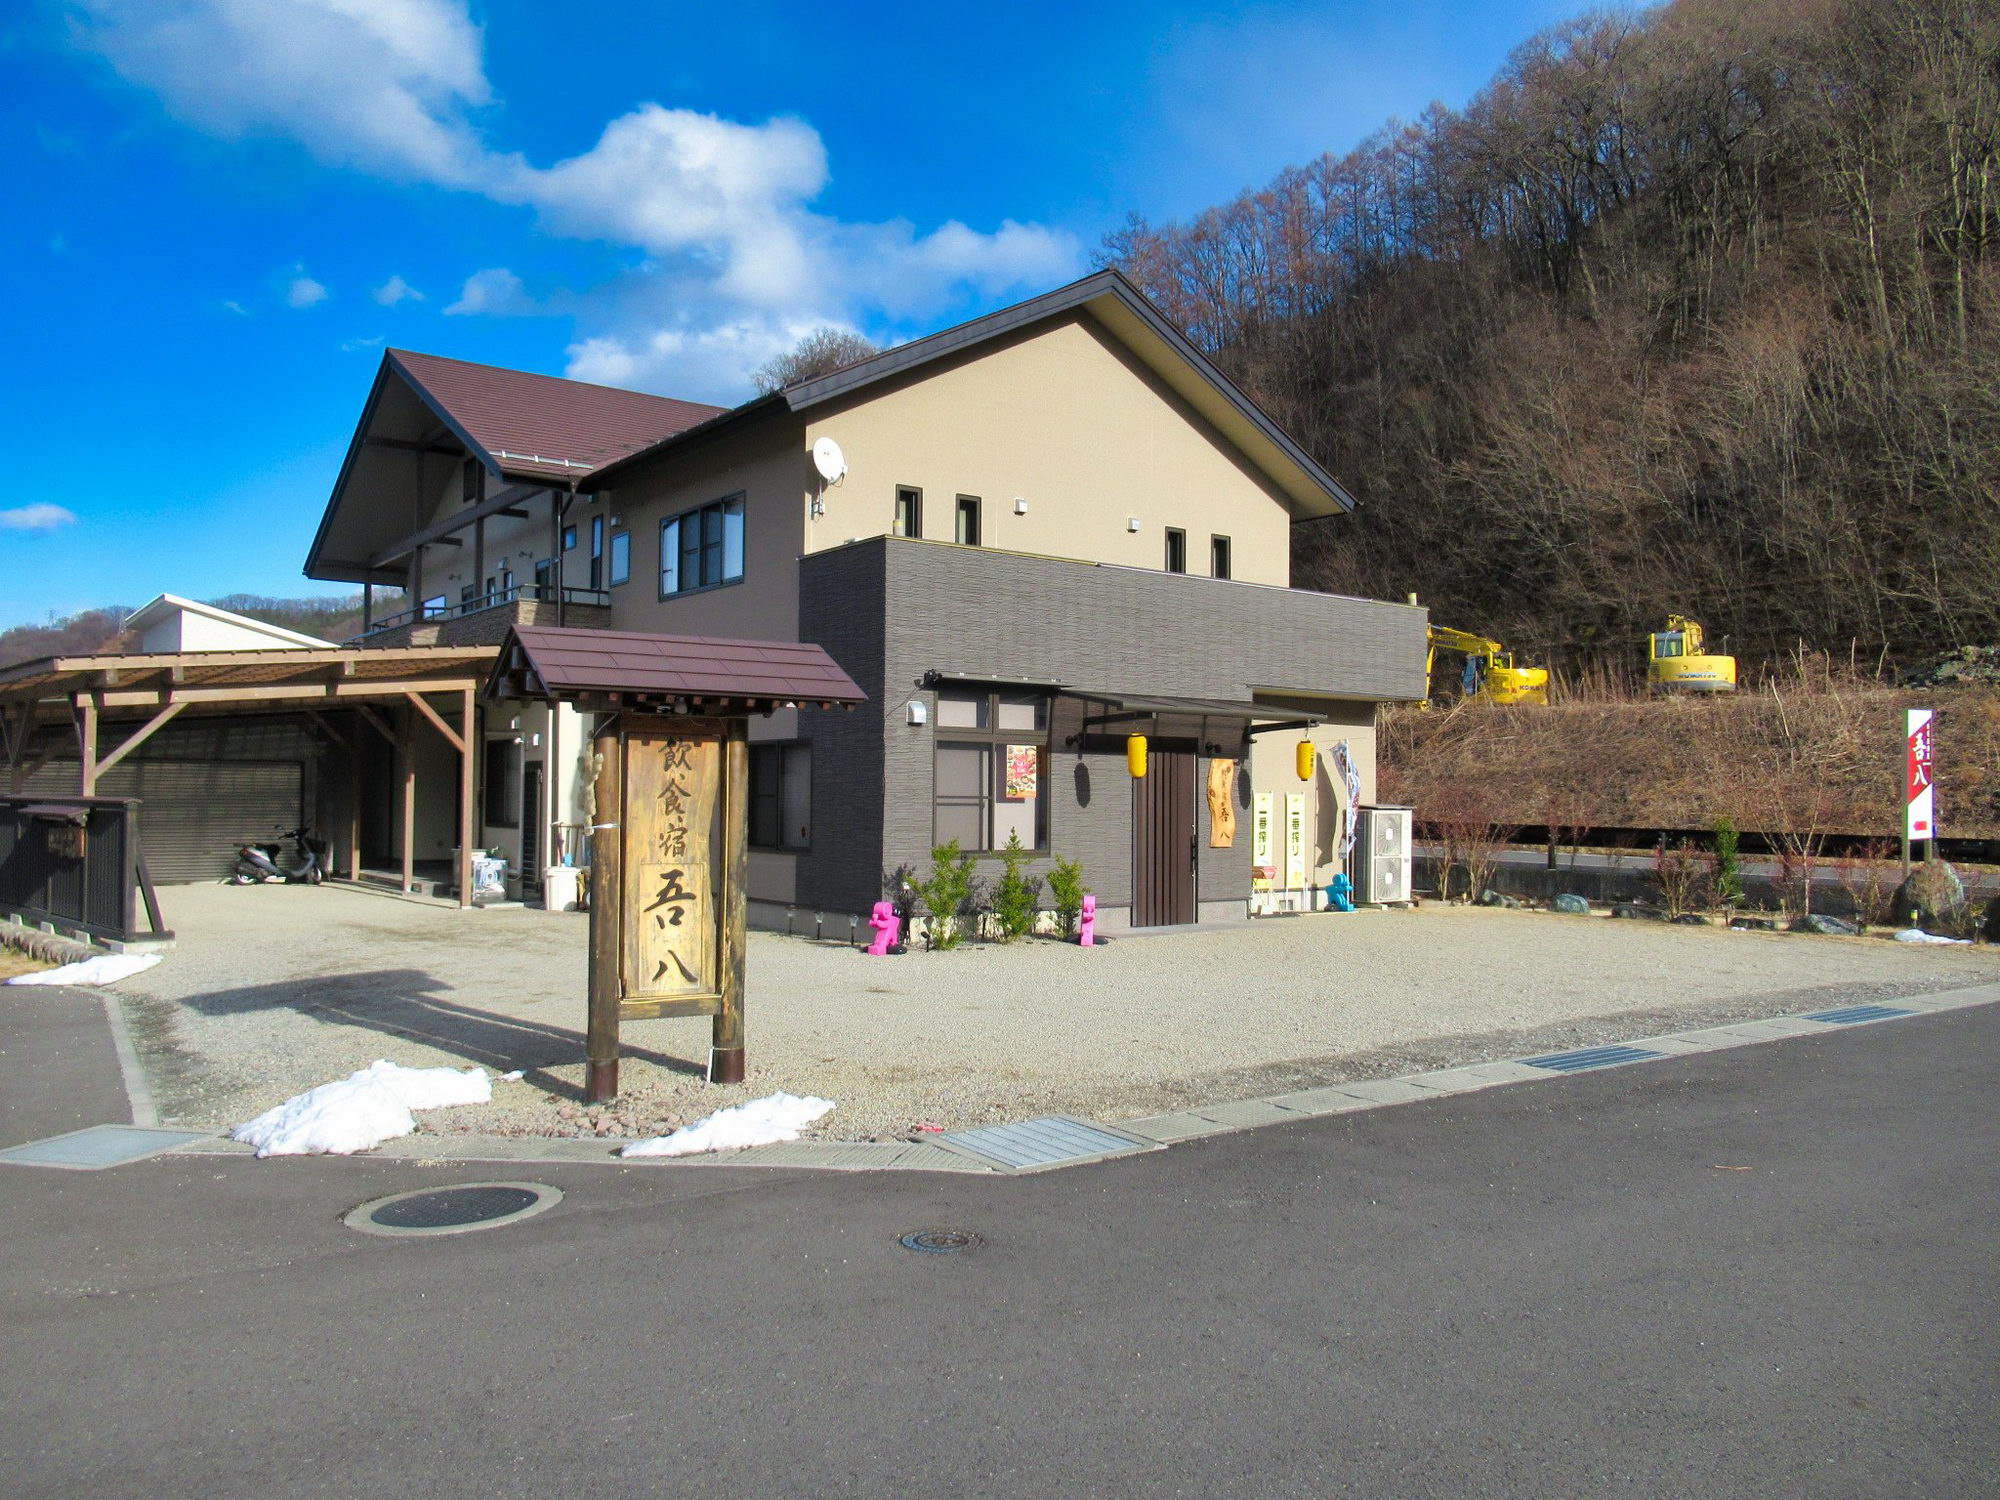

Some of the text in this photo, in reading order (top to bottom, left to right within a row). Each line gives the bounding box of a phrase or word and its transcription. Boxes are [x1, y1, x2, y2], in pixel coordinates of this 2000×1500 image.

[1258, 811, 1267, 856] 一番搾り
[1291, 812, 1300, 856] 一番搾り
[643, 869, 699, 983] 吾八
